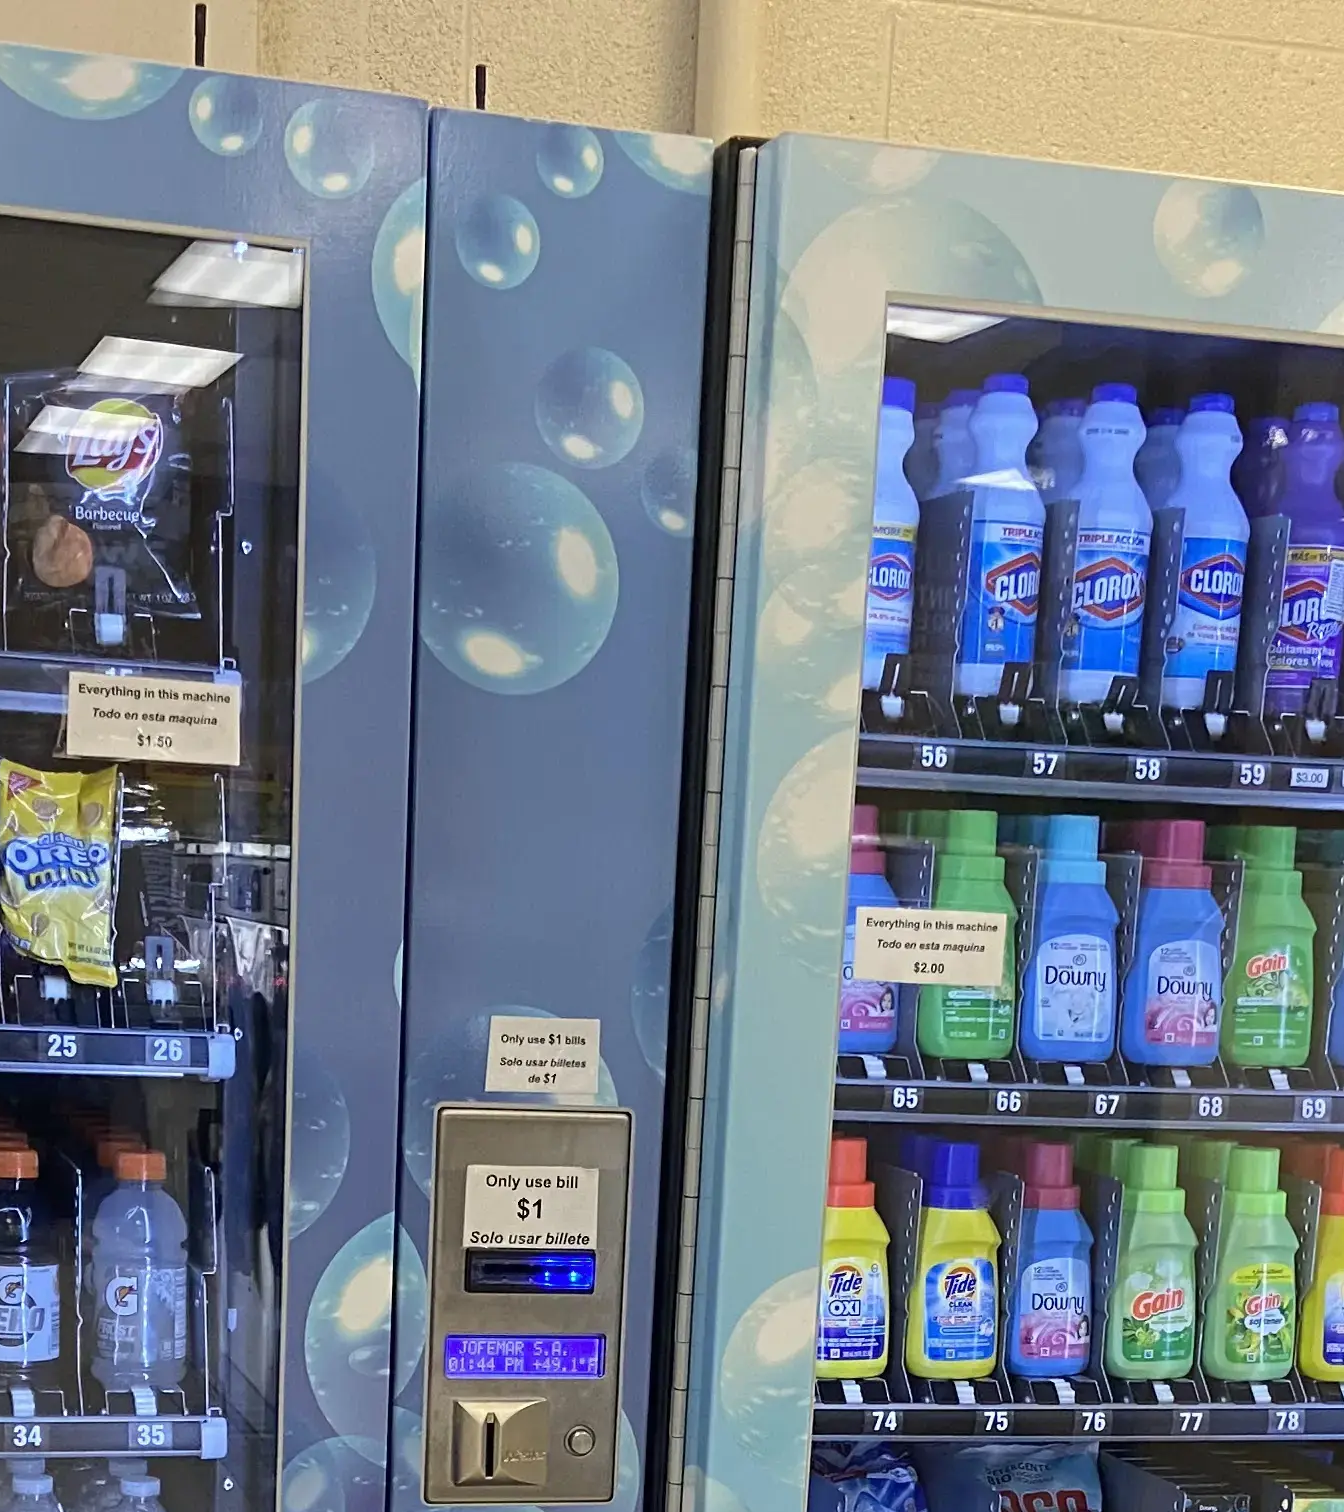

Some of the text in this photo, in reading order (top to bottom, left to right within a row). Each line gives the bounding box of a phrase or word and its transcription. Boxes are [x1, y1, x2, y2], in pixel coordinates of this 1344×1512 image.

[75, 506, 140, 523] Barbecue
[1072, 571, 1142, 608] CLOROX
[78, 684, 231, 703] Everything in this machine
[93, 708, 217, 727] Todo en esta maquina
[137, 734, 173, 748] $1.50
[921, 745, 948, 768] 56
[1032, 753, 1058, 776] 57
[1135, 758, 1160, 781] 58
[1239, 764, 1266, 785] 59
[6, 840, 108, 871] OREO
[866, 917, 998, 932] Everything in this machine
[877, 939, 985, 954] Todo en esta maquina
[913, 962, 944, 974] $2.00
[1246, 954, 1289, 979] Gain
[1044, 965, 1106, 991] Downy
[1157, 976, 1213, 1001] Downy
[47, 1034, 77, 1057] 25
[501, 1033, 586, 1046] Only use $1 bills
[153, 1039, 183, 1062] 26
[500, 1057, 586, 1068] Solo usar billetes
[528, 1073, 556, 1085] de $1
[892, 1087, 918, 1109] 65
[996, 1090, 1021, 1112] 66
[1095, 1094, 1120, 1115] 67
[1198, 1095, 1223, 1117] 68
[1301, 1098, 1326, 1119] 69
[486, 1175, 578, 1191] Only use bill
[517, 1198, 542, 1221] $1
[470, 1231, 590, 1246] Solo usar billete
[829, 1271, 863, 1298] Tide
[944, 1273, 977, 1299] Tide
[829, 1300, 860, 1316] OXI
[1032, 1293, 1085, 1315] Downy
[1132, 1287, 1185, 1320] Gain
[1246, 1293, 1281, 1315] Gain
[459, 1340, 568, 1356] JOFEMAR S.A.
[448, 1357, 495, 1372] 01:44
[505, 1358, 524, 1372] PM
[872, 1411, 898, 1431] 74
[984, 1411, 1008, 1431] 75
[1082, 1411, 1106, 1431] 76
[1179, 1411, 1204, 1432] 77
[1276, 1411, 1299, 1432] 78
[13, 1424, 42, 1448] 34
[137, 1423, 166, 1446] 35
